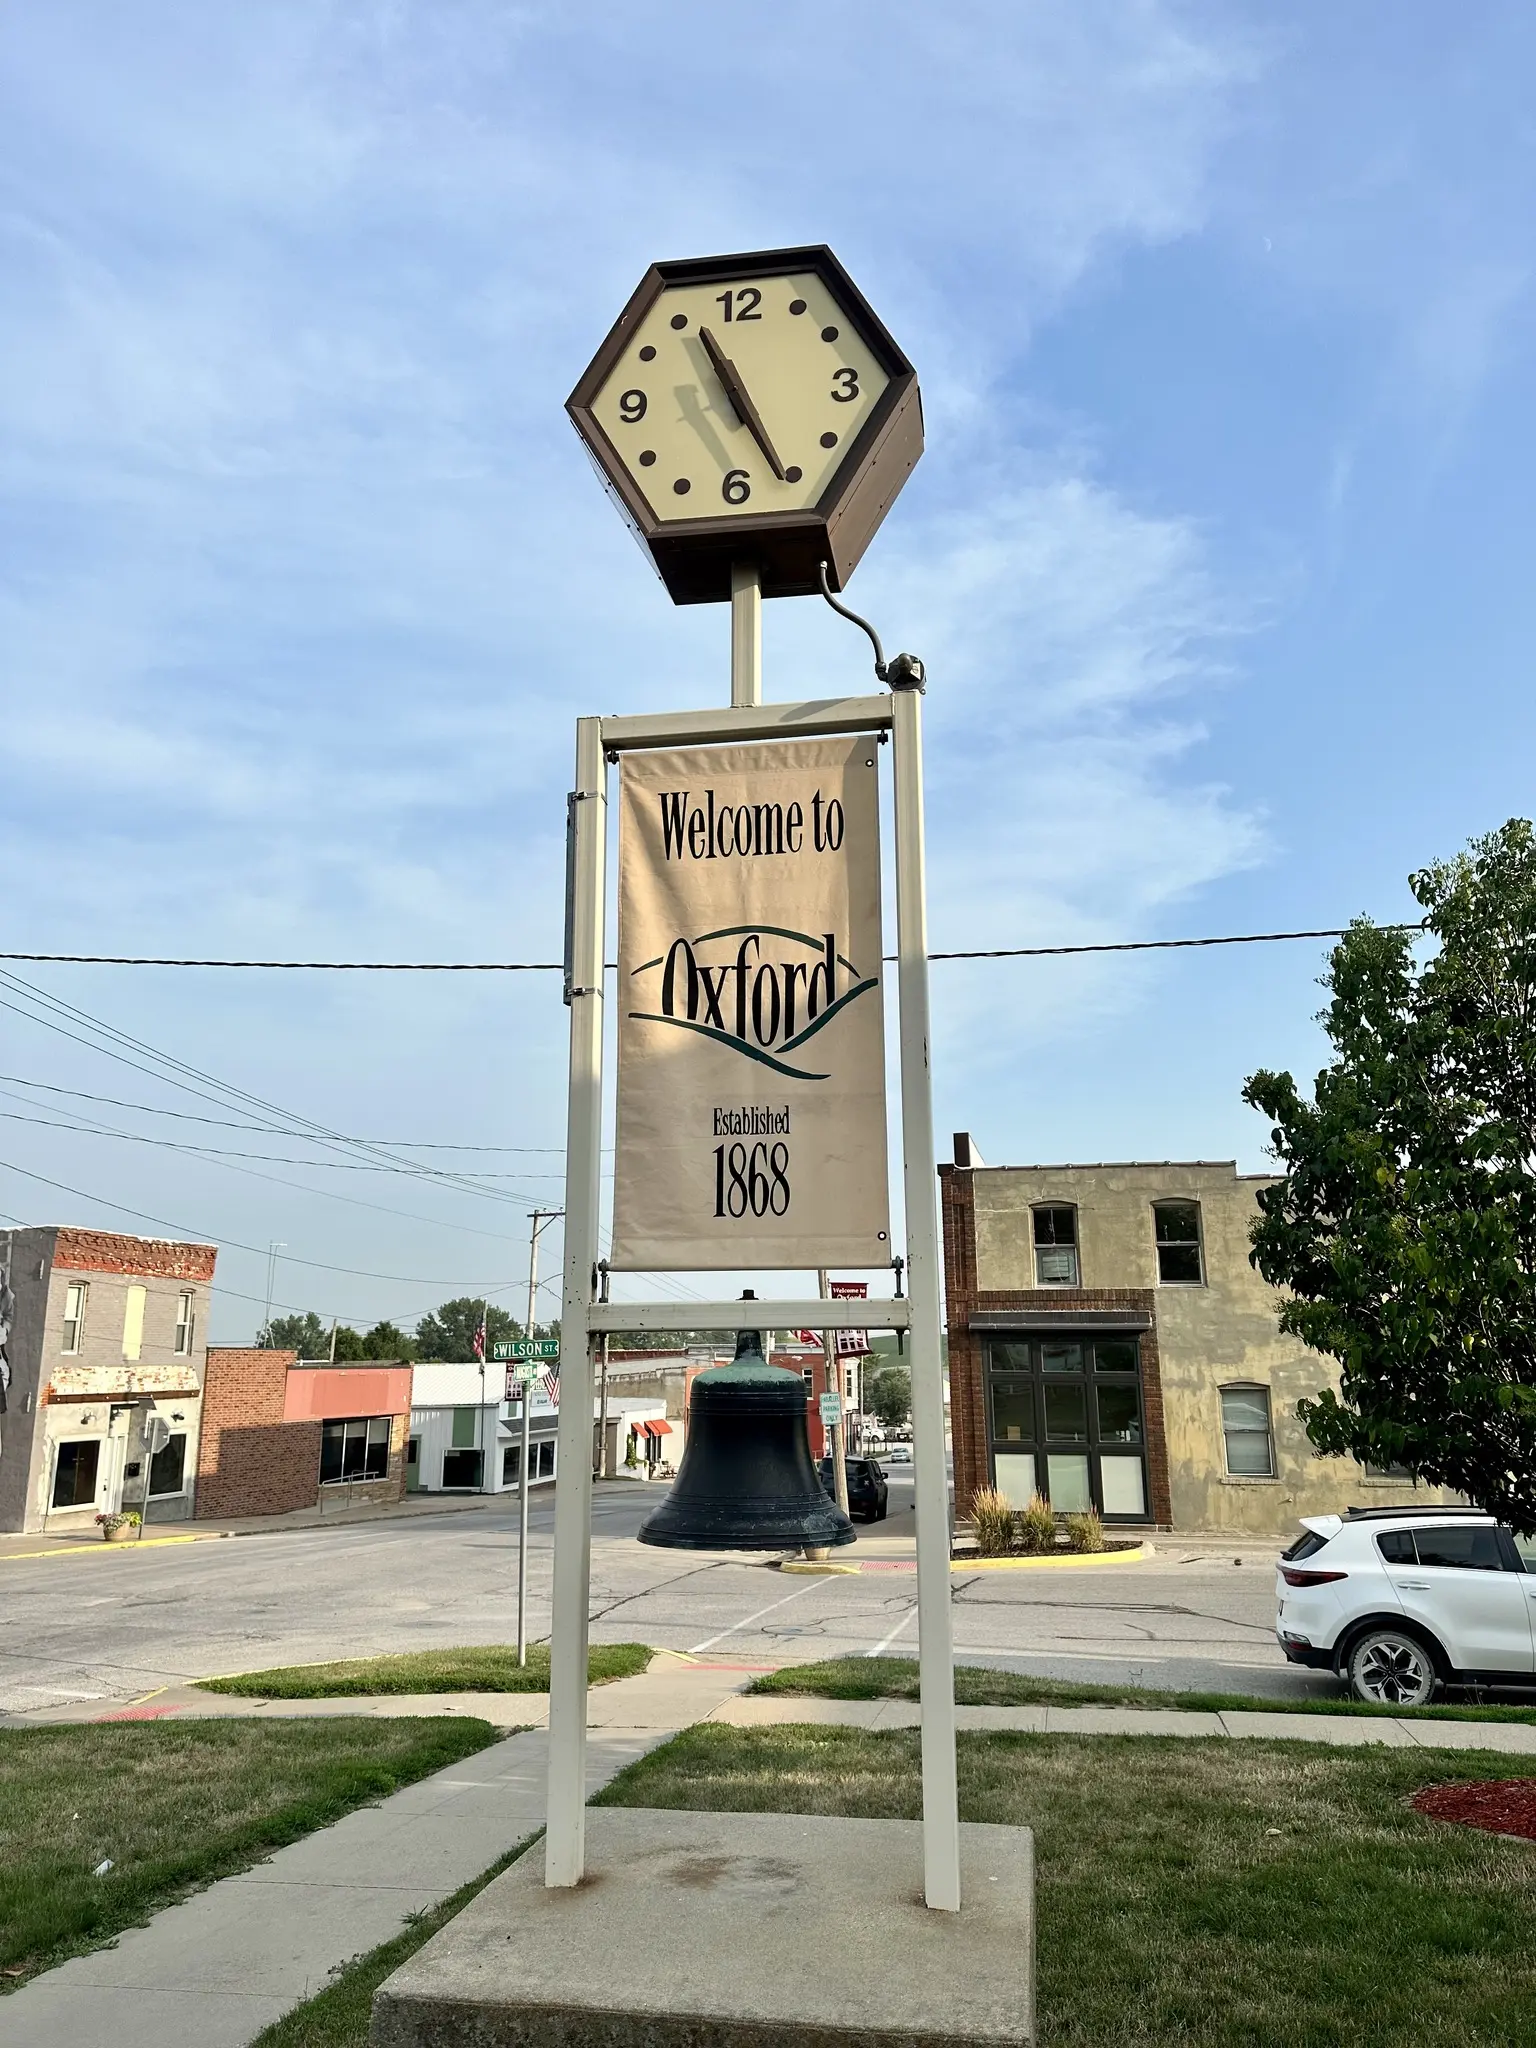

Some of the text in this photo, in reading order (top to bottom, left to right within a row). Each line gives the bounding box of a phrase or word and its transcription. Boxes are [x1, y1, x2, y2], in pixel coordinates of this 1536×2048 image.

[716, 288, 763, 322] 12
[831, 367, 859, 402] 3
[619, 389, 648, 423] 9
[721, 469, 751, 504] 6
[657, 789, 844, 861] Welcome to
[662, 934, 835, 1047] Oxford
[713, 1105, 790, 1136] Established
[712, 1141, 790, 1218] 1868
[499, 1342, 543, 1357] WILSON
